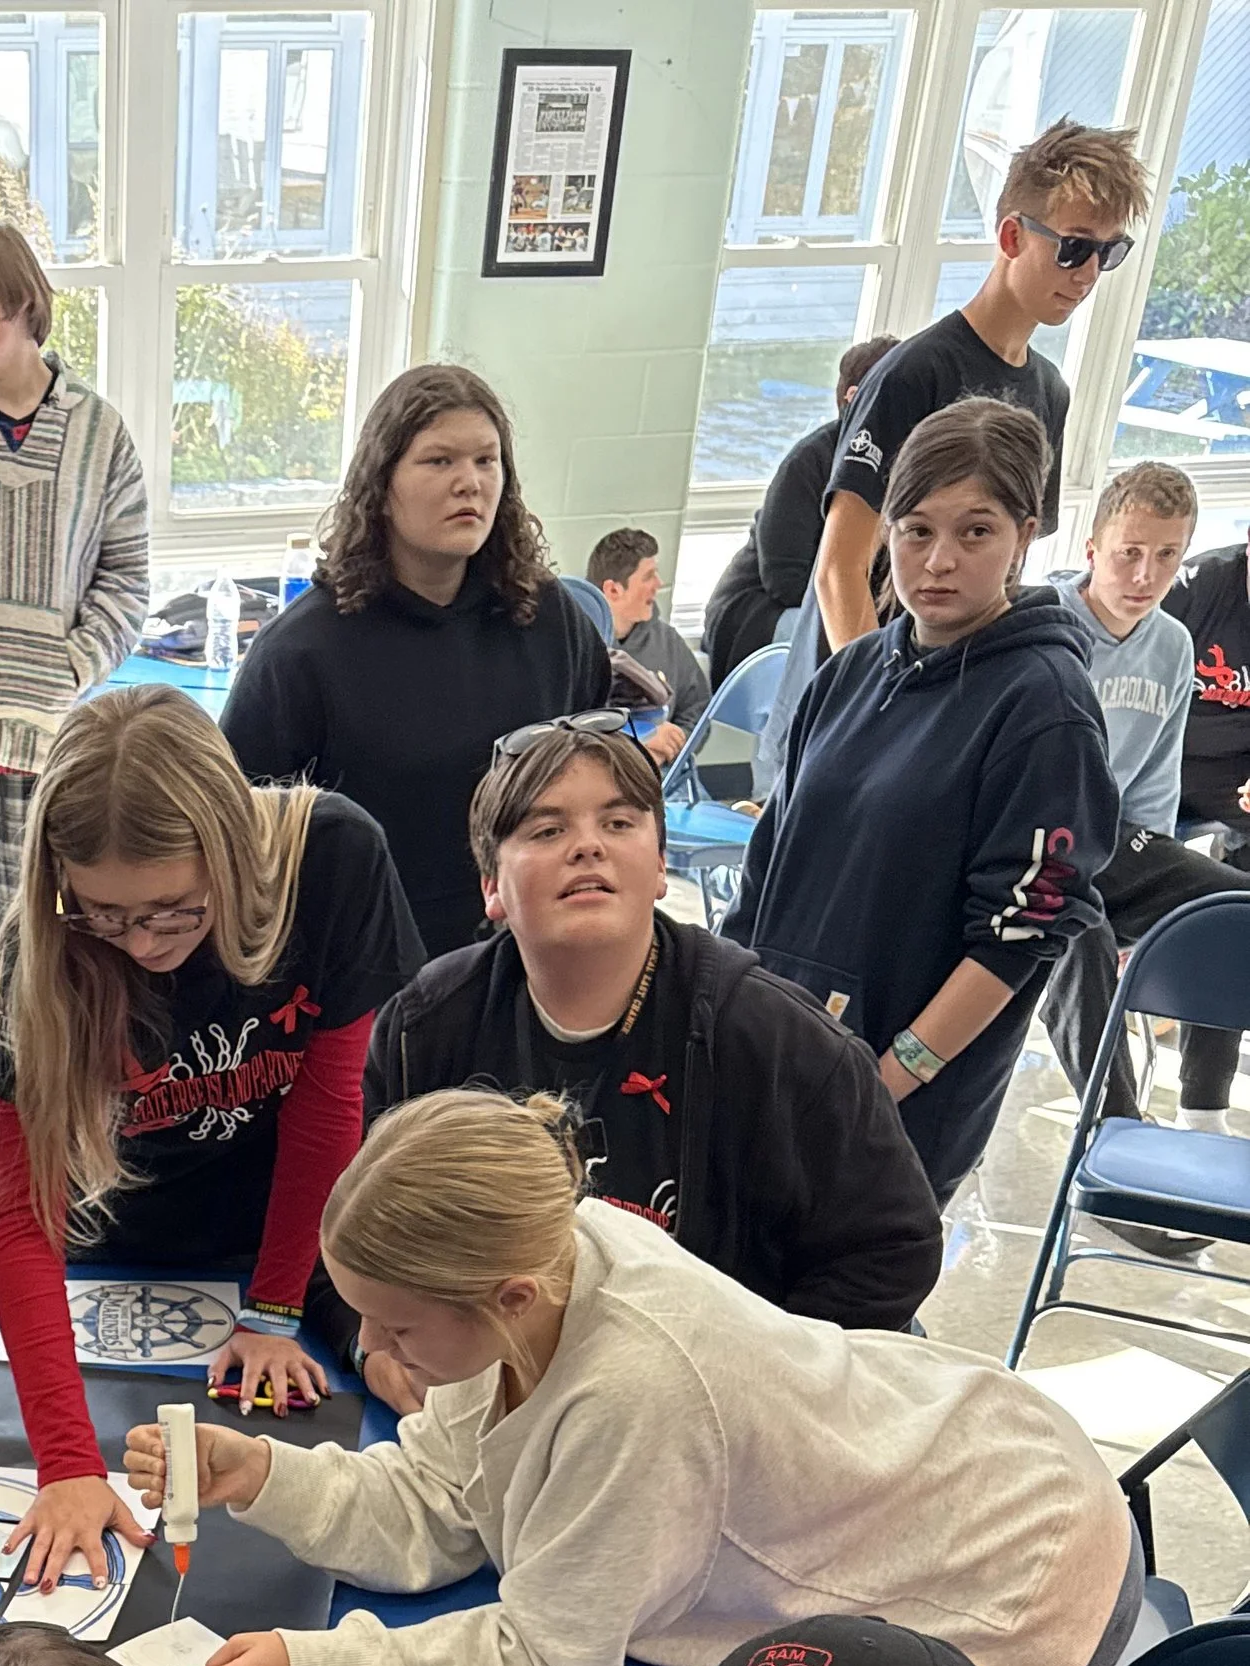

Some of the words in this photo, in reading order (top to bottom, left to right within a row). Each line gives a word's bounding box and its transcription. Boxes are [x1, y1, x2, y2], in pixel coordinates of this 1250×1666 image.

[1101, 676, 1168, 719] CAROLINA
[206, 1063, 252, 1110] ISLAND
[101, 1299, 125, 1346] MARINERS
[764, 1648, 807, 1662] RAM
